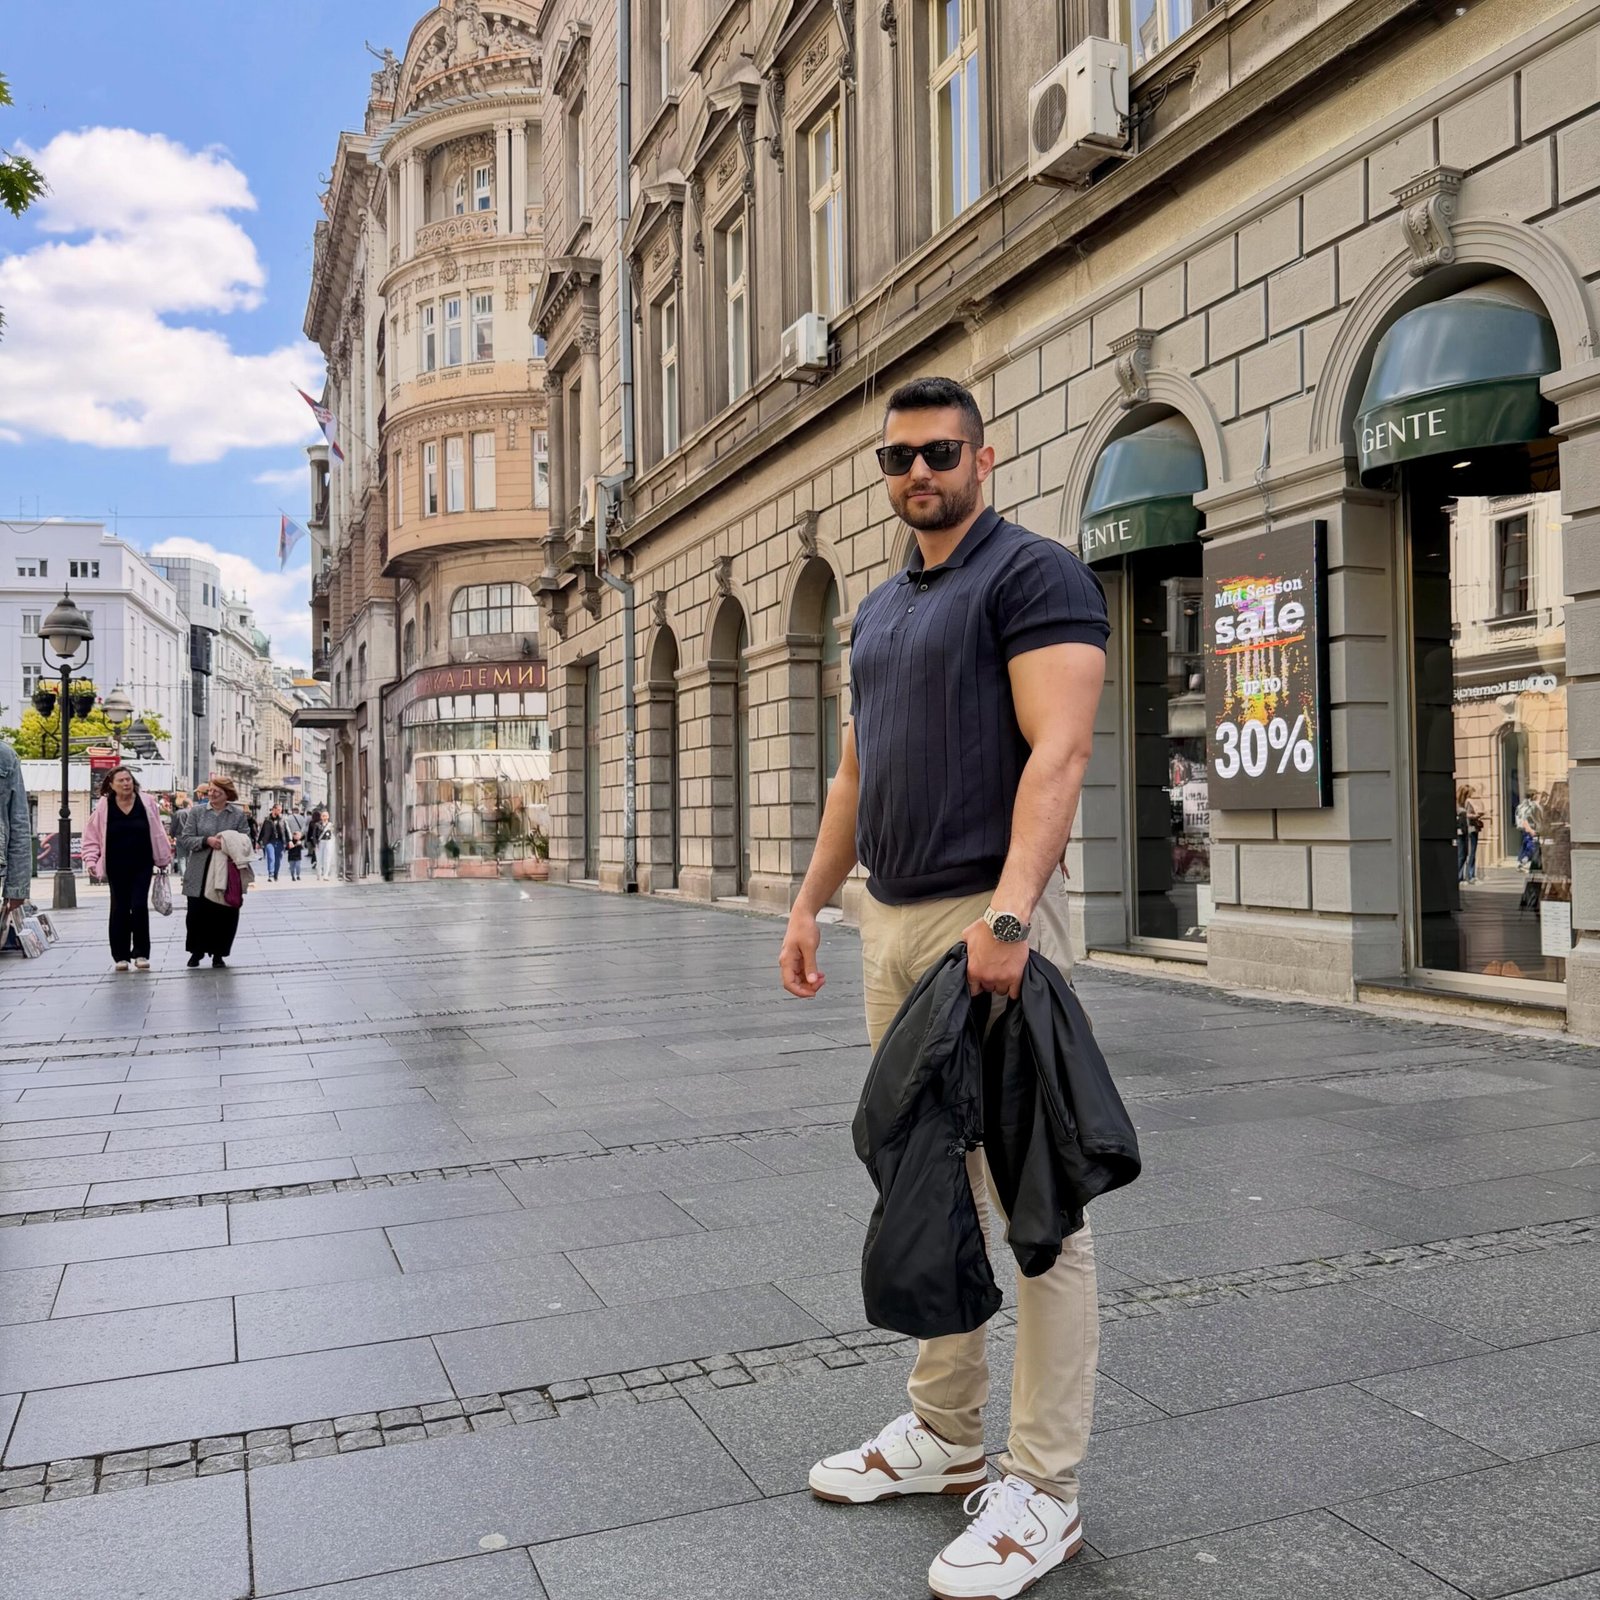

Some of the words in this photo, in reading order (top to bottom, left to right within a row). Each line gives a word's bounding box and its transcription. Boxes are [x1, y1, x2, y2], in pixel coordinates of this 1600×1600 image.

[1361, 408, 1447, 453] GENTE
[1081, 518, 1132, 552] GENTE
[1246, 578, 1303, 599] Season
[1215, 597, 1305, 644] sale
[1215, 714, 1314, 779] 30%
